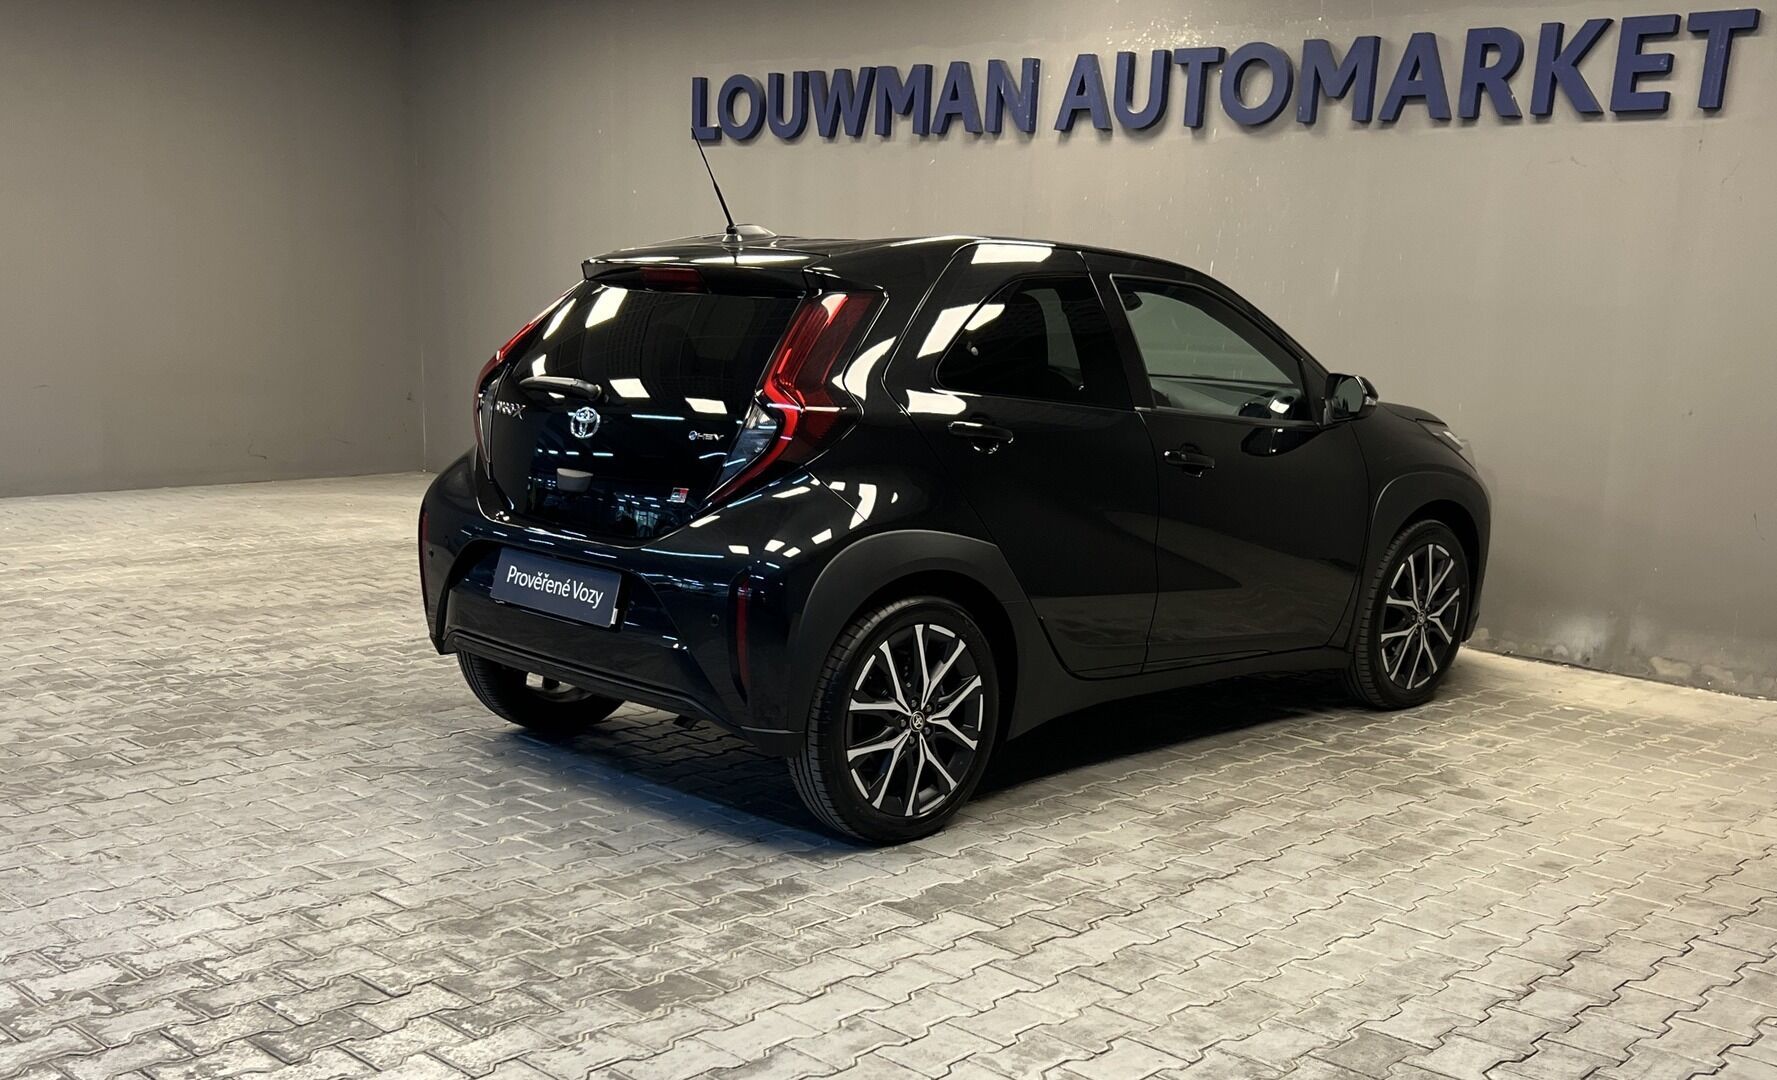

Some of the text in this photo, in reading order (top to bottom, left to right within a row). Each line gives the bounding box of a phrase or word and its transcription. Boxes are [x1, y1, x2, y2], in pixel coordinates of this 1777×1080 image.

[691, 8, 1762, 141] LOUWMAN AUTOMARKET
[506, 565, 604, 609] Prověřené Vozy
